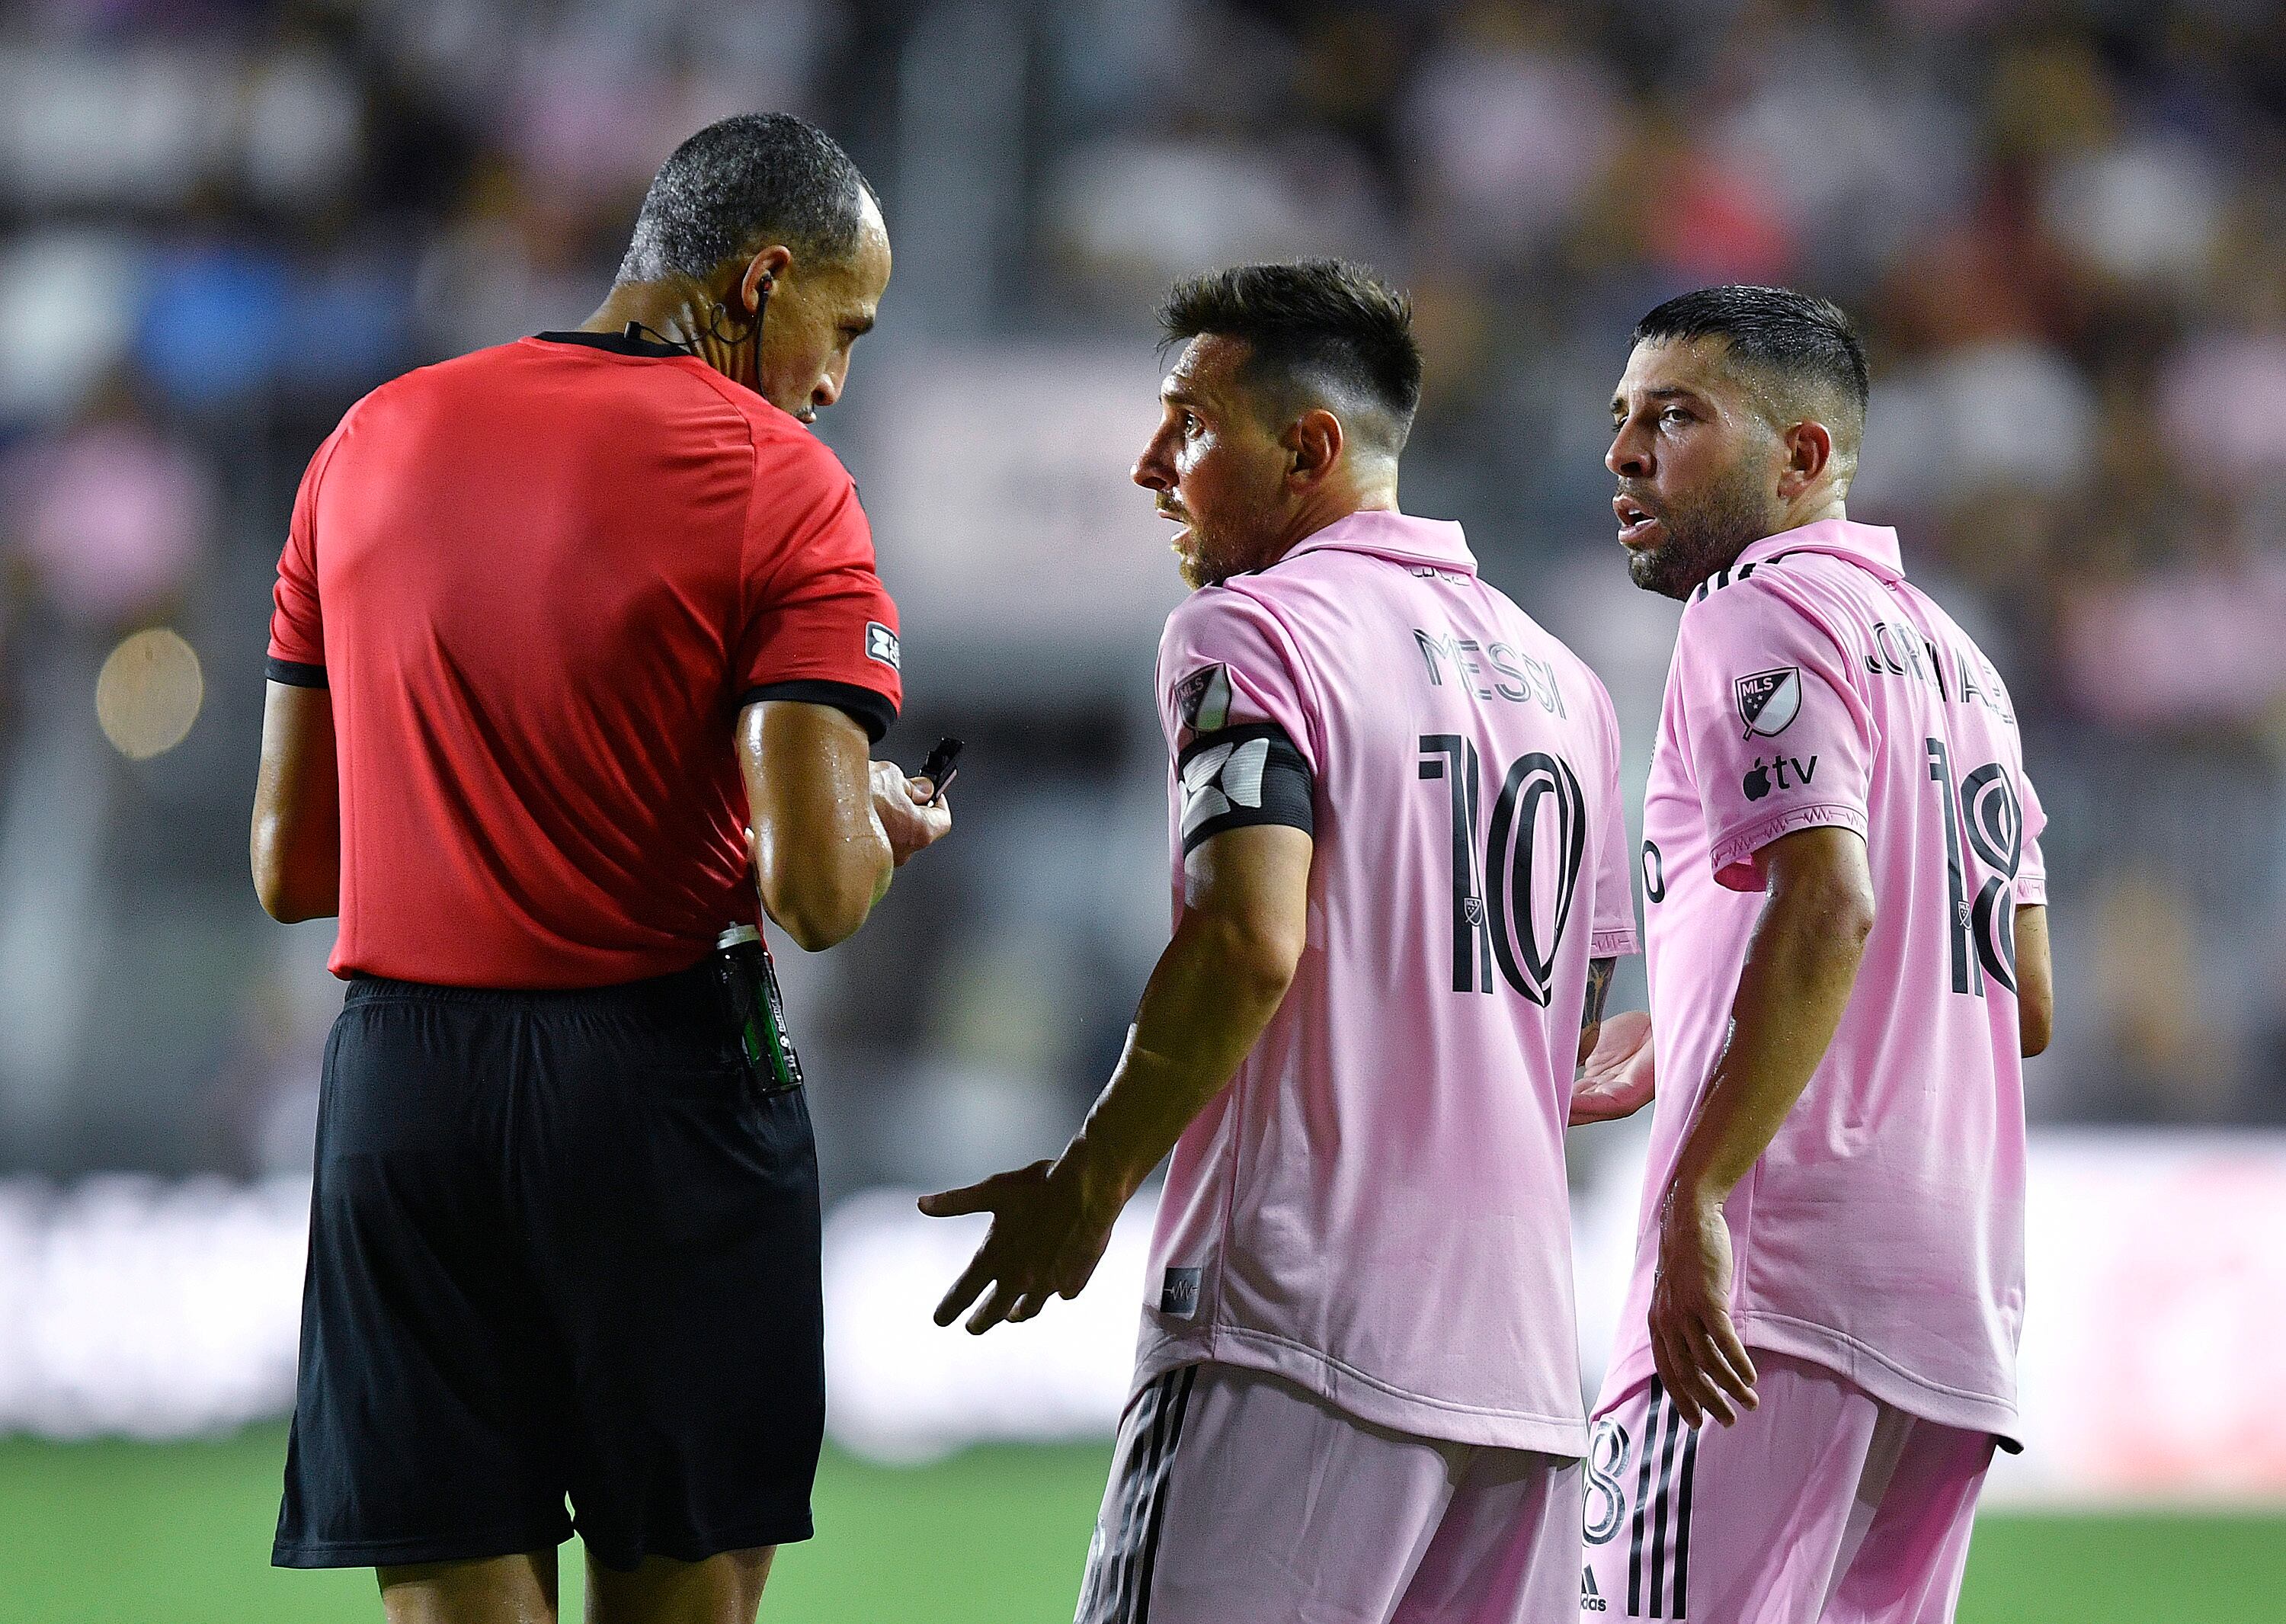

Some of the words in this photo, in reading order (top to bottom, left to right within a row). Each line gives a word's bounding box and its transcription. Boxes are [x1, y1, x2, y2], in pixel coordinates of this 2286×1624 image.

[1179, 676, 1204, 698] MLS
[1413, 629, 1567, 720] MESSI
[1742, 677, 1774, 697] MLS
[1772, 754, 1818, 790] tv
[1419, 733, 1586, 1008] 10
[1925, 736, 2022, 998] 18
[1580, 1593, 1607, 1612] das
